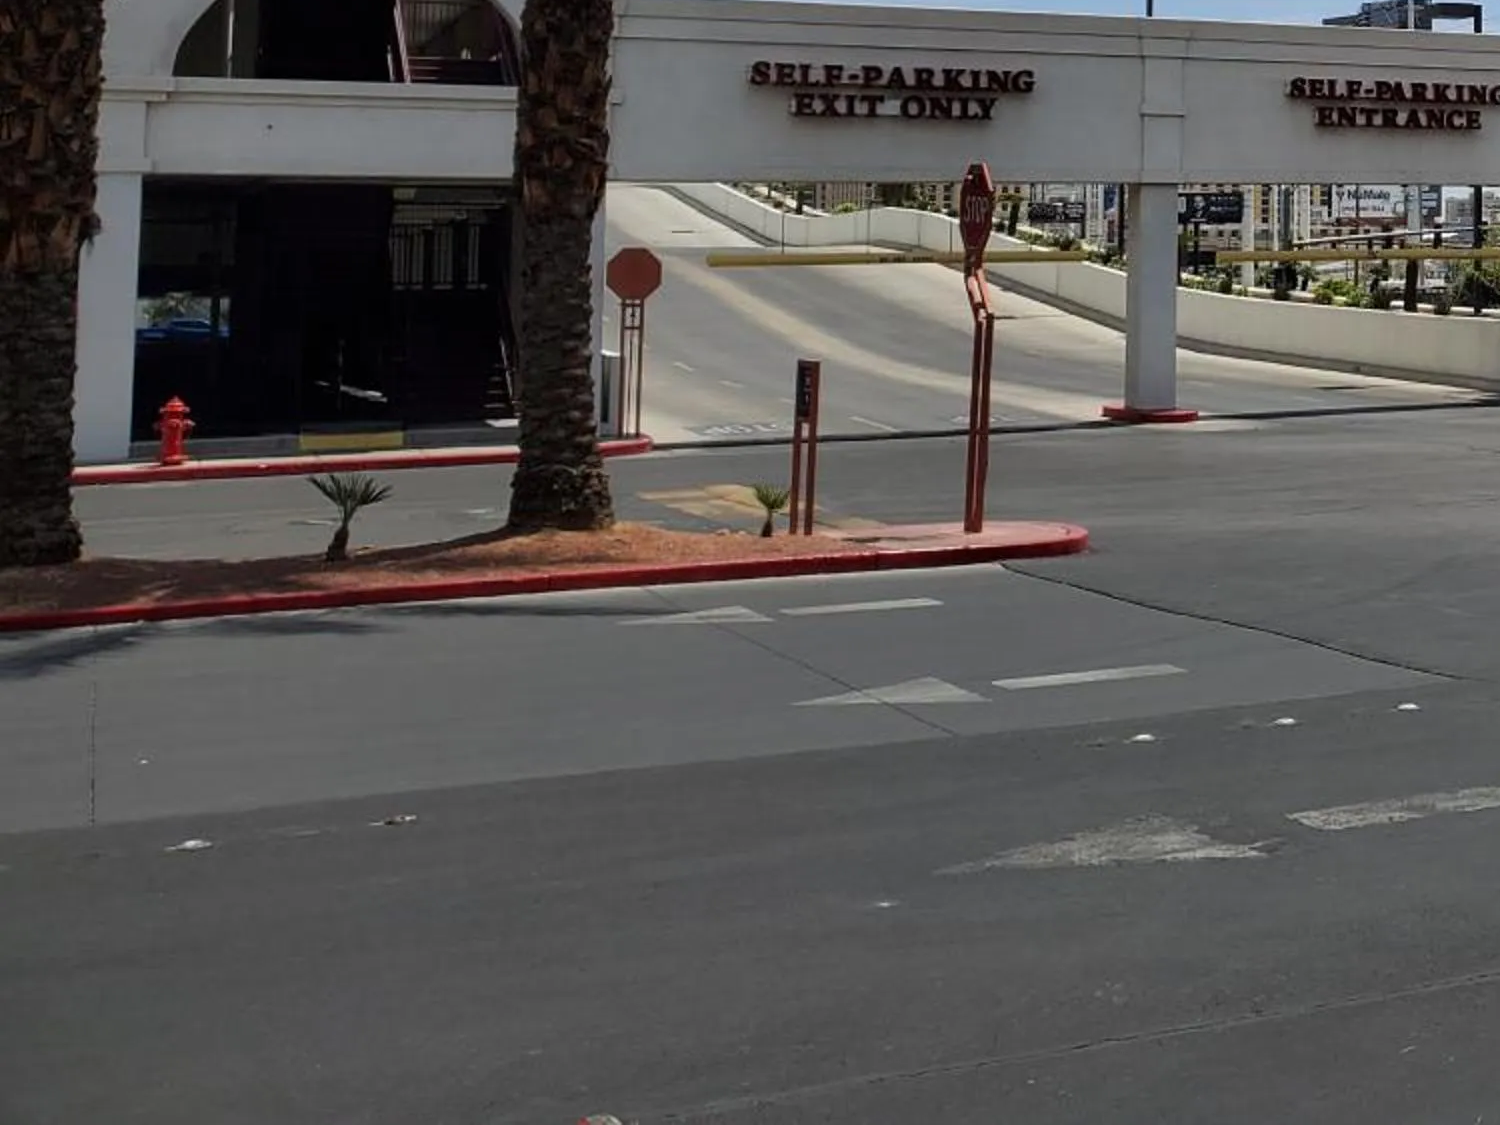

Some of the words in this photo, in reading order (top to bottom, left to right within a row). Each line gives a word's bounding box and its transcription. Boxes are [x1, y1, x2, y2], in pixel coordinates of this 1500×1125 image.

[750, 61, 1035, 93] SELF-PARKING
[790, 93, 884, 117] EXIT
[900, 95, 998, 120] ONLY
[1315, 106, 1482, 130] ENTRANCE
[963, 196, 988, 223] STOP
